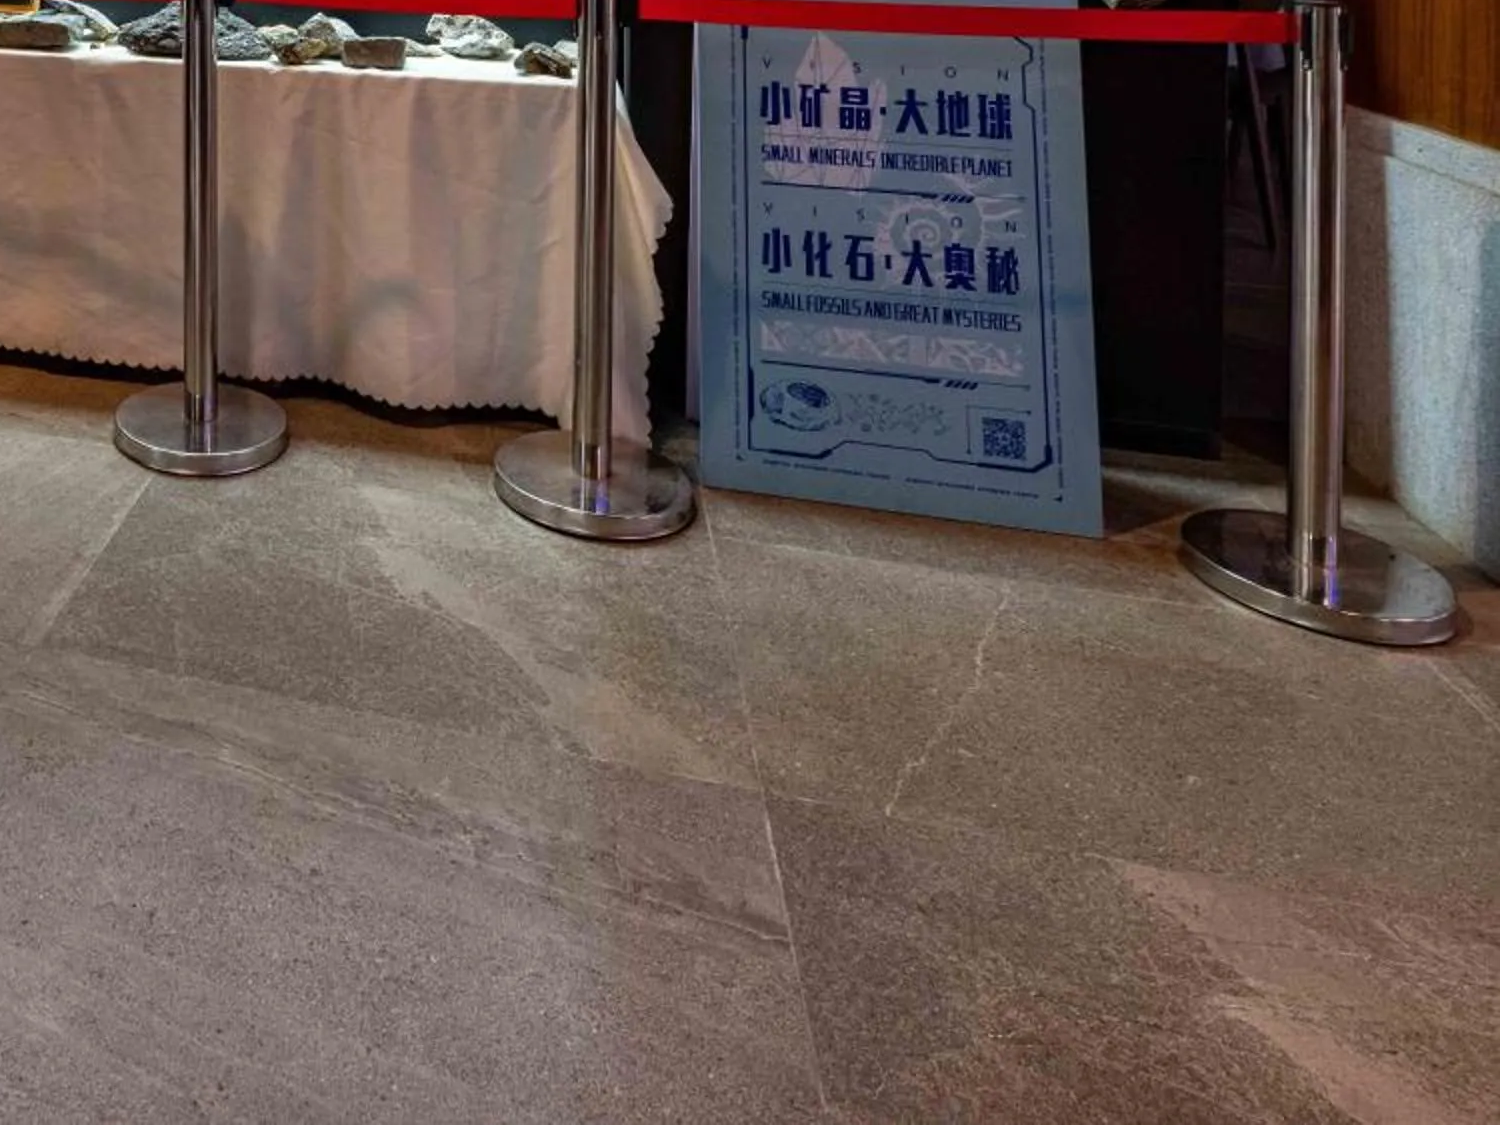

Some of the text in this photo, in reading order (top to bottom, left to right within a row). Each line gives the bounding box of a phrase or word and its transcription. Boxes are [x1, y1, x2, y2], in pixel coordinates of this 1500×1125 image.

[761, 142, 1013, 178] SMALL MINERALS INCREDIBLE PLANET
[761, 290, 1022, 333] SMALL FOSSILS AND GREAT MYSTERIES
